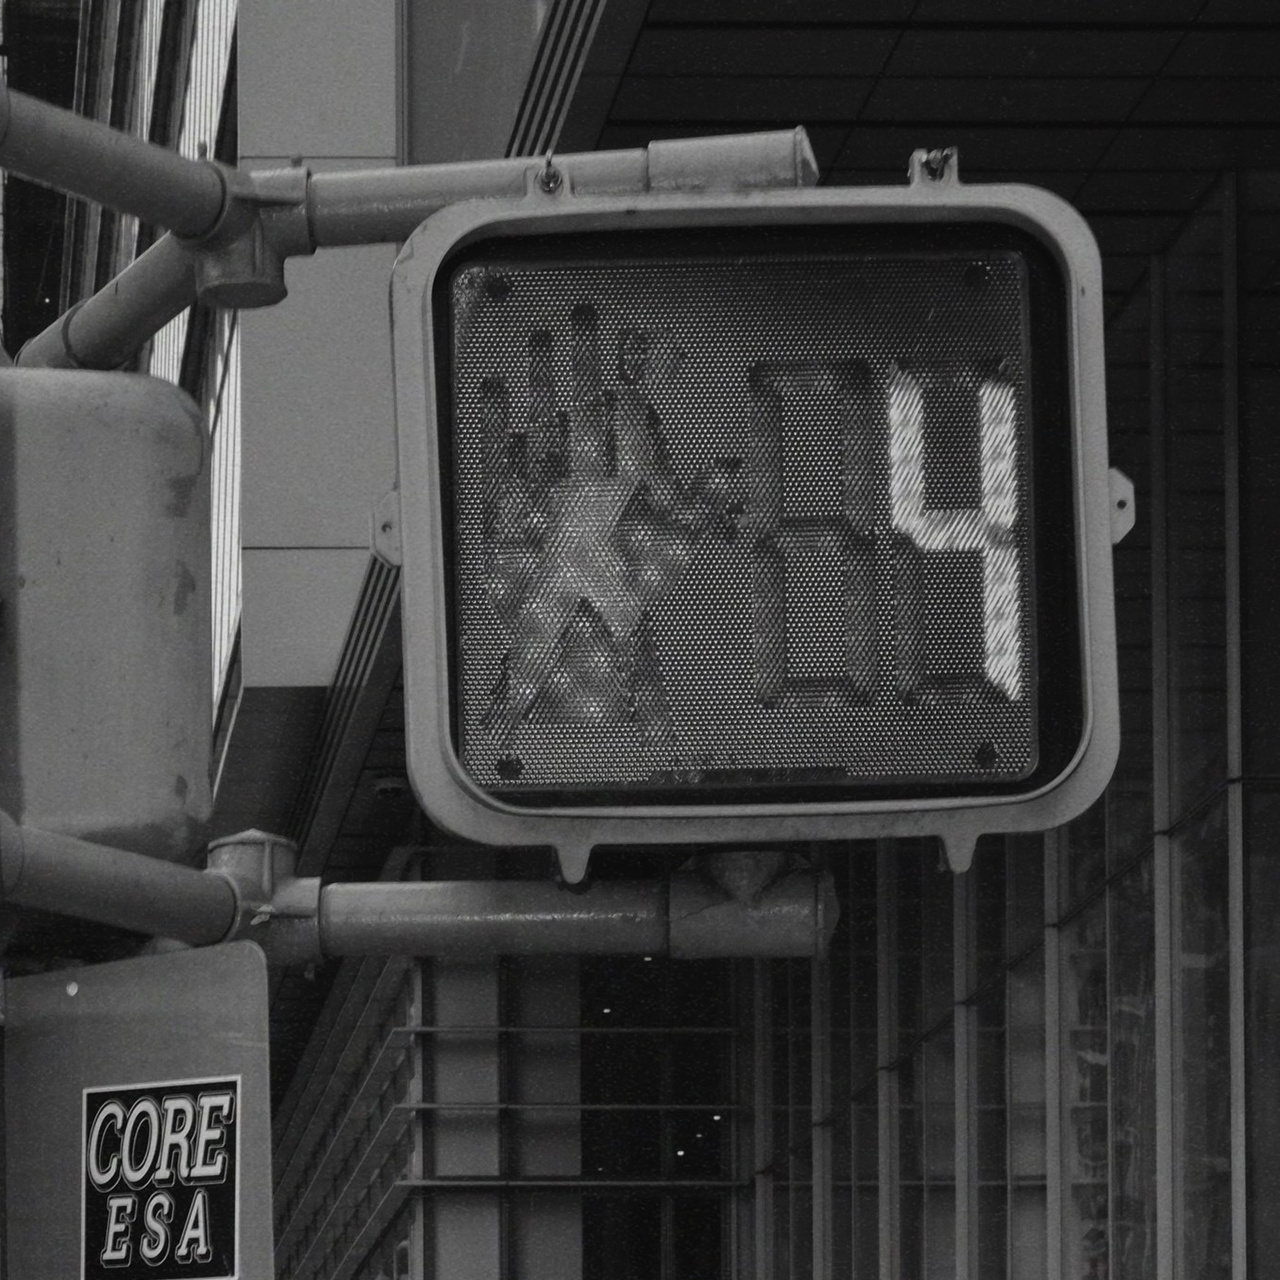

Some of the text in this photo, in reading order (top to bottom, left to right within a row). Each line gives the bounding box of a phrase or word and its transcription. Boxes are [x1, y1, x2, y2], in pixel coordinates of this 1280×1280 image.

[889, 362, 1022, 703] 4
[88, 1093, 234, 1192] CORE
[100, 1189, 212, 1267] ESA
